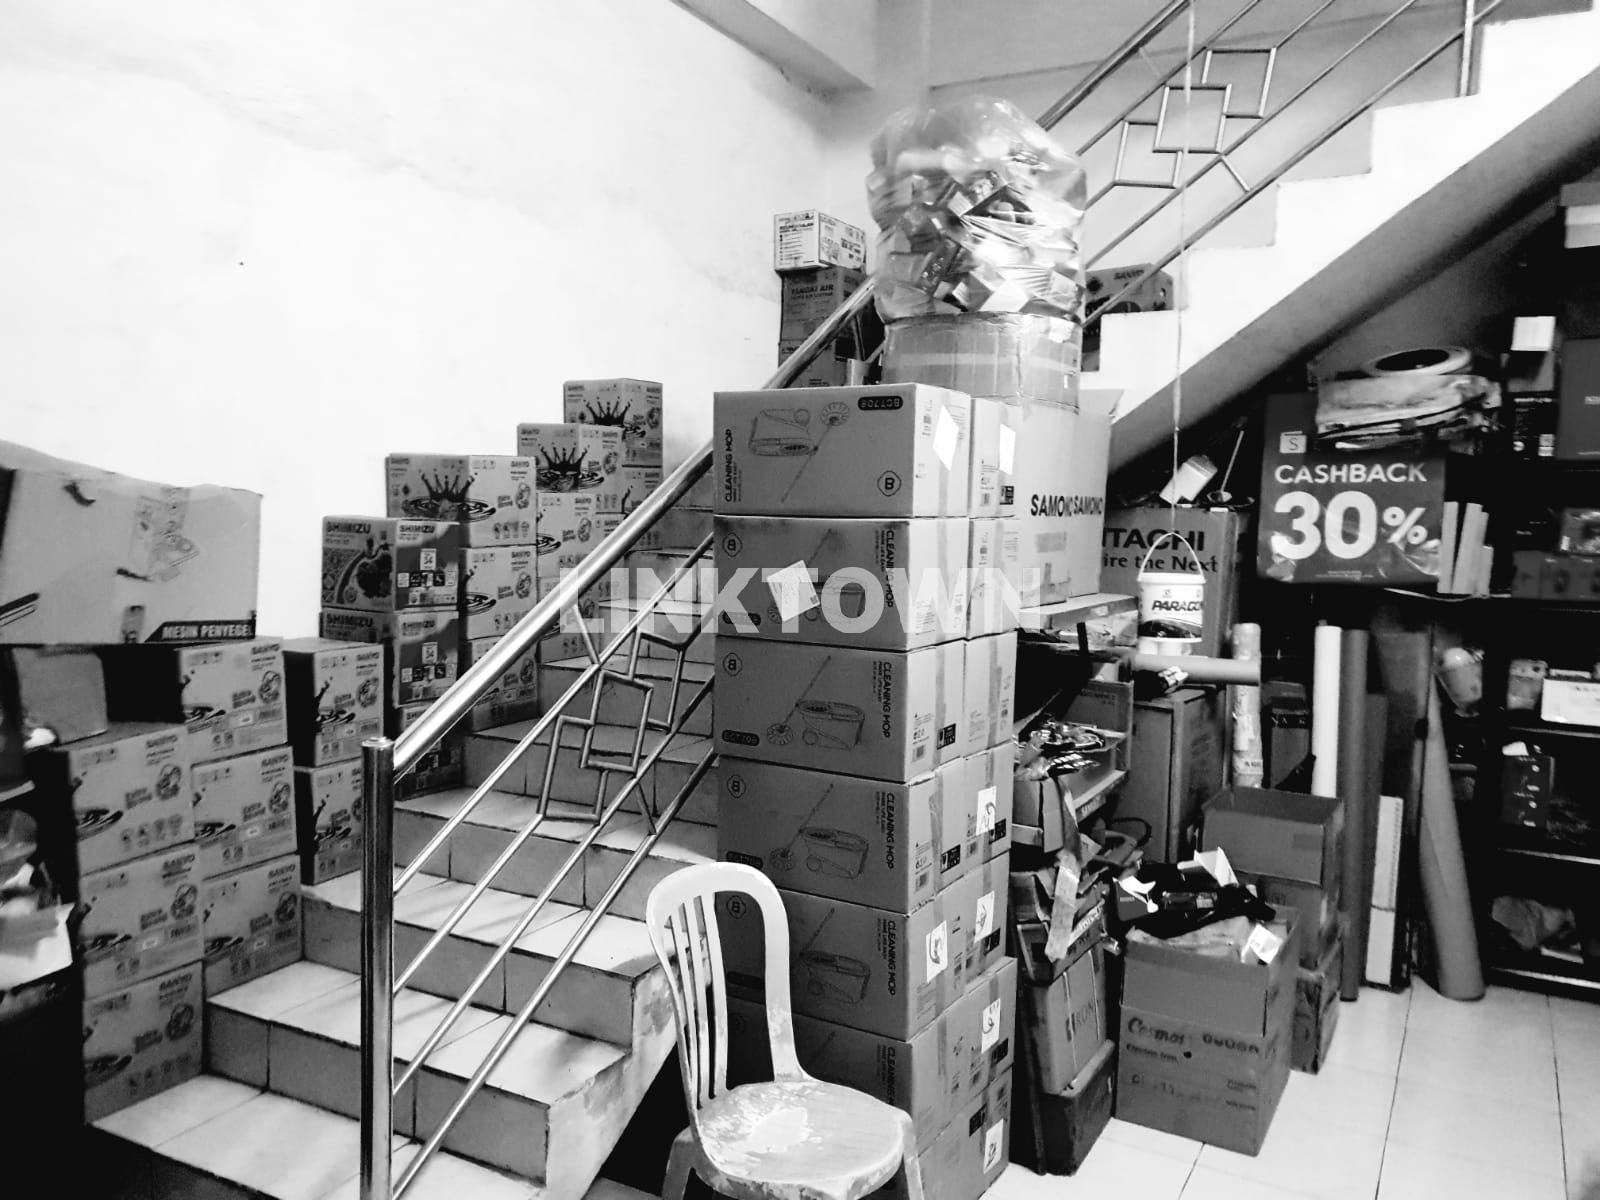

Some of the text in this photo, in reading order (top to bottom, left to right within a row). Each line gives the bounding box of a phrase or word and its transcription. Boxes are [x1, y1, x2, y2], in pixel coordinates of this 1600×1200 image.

[725, 429, 733, 502] CLEANING MOP
[884, 477, 895, 490] B
[1274, 462, 1428, 484] CASHBACK
[1102, 527, 1206, 552] ITACHI
[1270, 490, 1429, 560] 30%
[1134, 555, 1165, 570] the
[1171, 555, 1218, 573] Next
[882, 662, 892, 738] CLEANING MOP
[886, 792, 895, 870] CLEANING MOP
[888, 920, 896, 996] CLEANING MOP
